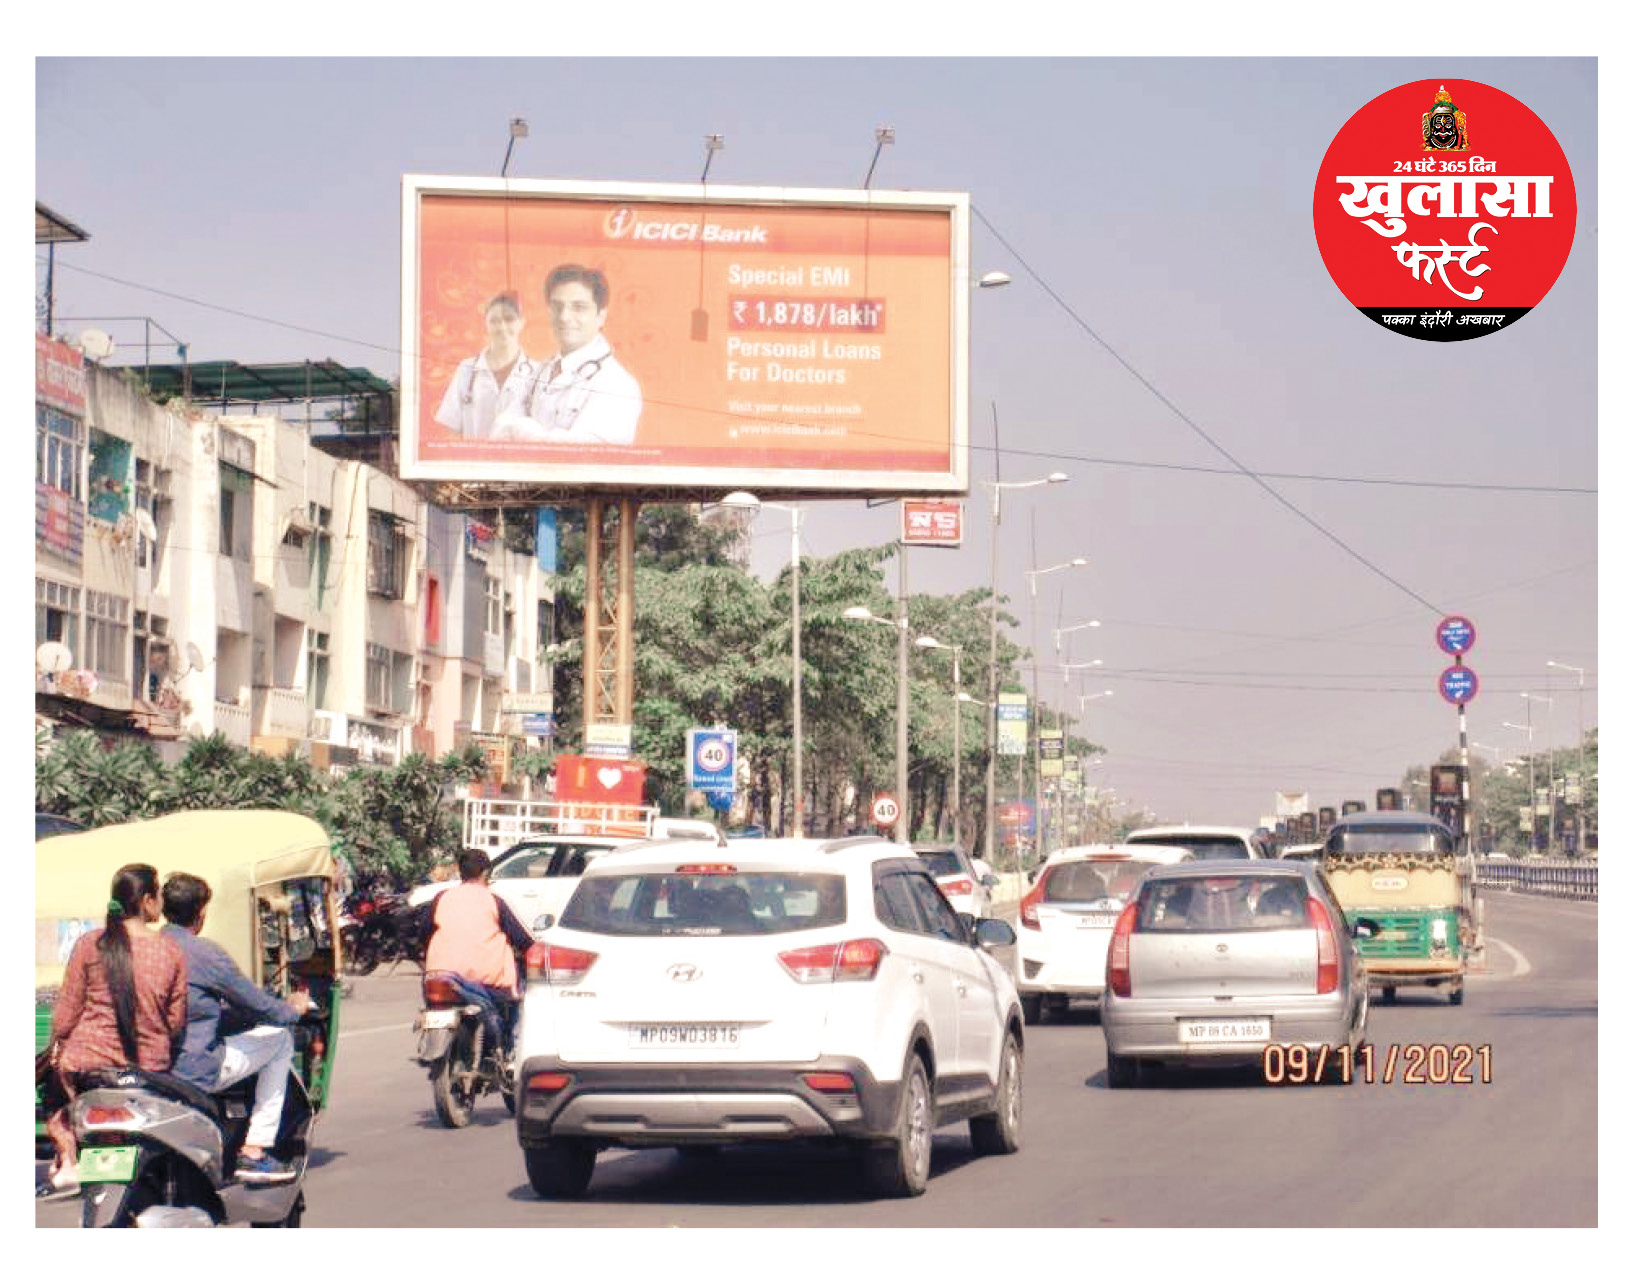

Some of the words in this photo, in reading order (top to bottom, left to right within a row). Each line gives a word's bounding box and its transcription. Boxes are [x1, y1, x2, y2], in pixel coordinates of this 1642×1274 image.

[633, 222, 699, 241] ICICI
[701, 223, 769, 244] Bank
[728, 263, 804, 289] Special
[810, 265, 850, 288] EMI
[726, 335, 817, 359] Personal
[822, 339, 882, 361] Loans
[726, 361, 761, 382] For
[766, 362, 847, 385] Doctors
[704, 749, 723, 762] 40
[878, 804, 896, 817] 40
[1188, 1026, 1207, 1038] MP
